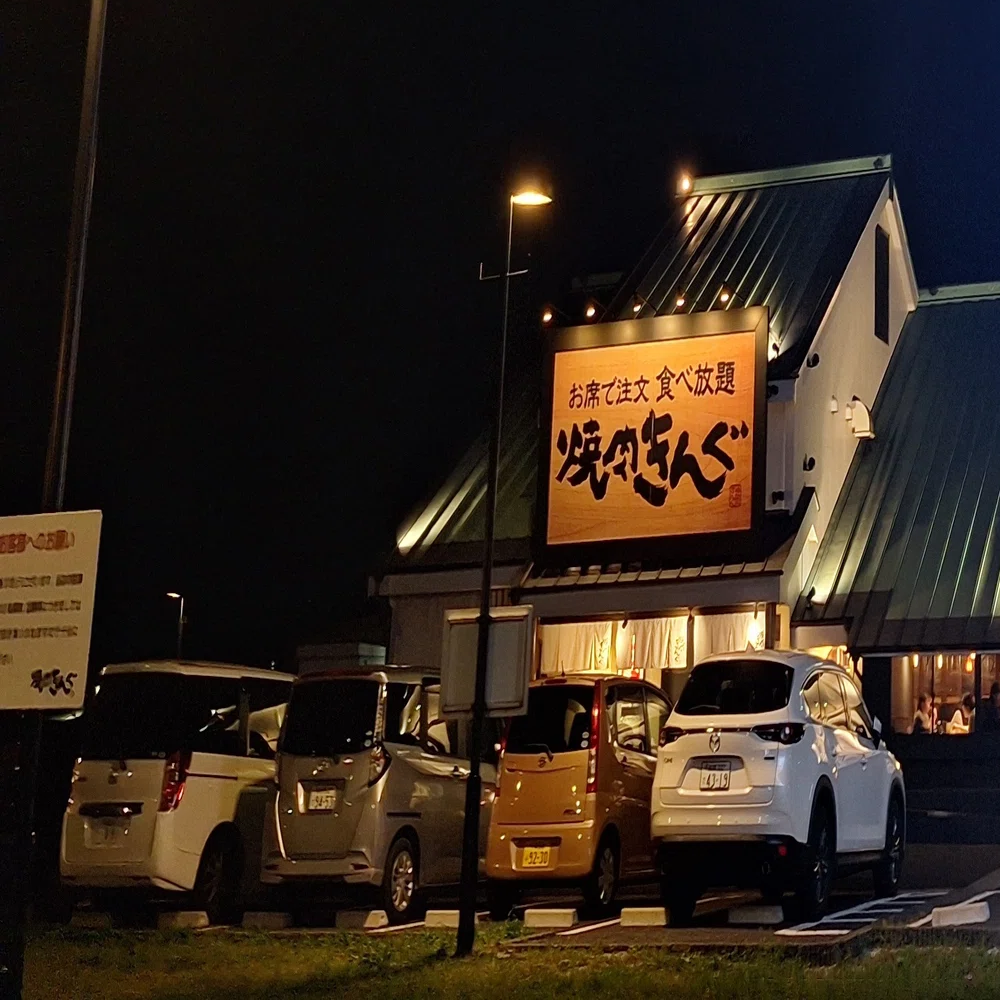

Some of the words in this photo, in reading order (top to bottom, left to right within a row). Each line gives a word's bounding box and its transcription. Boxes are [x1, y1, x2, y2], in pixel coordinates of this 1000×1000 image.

[568, 374, 650, 410] お席で注文
[655, 360, 736, 403] 食べ放題
[556, 408, 750, 507] 焼肉きんぐ
